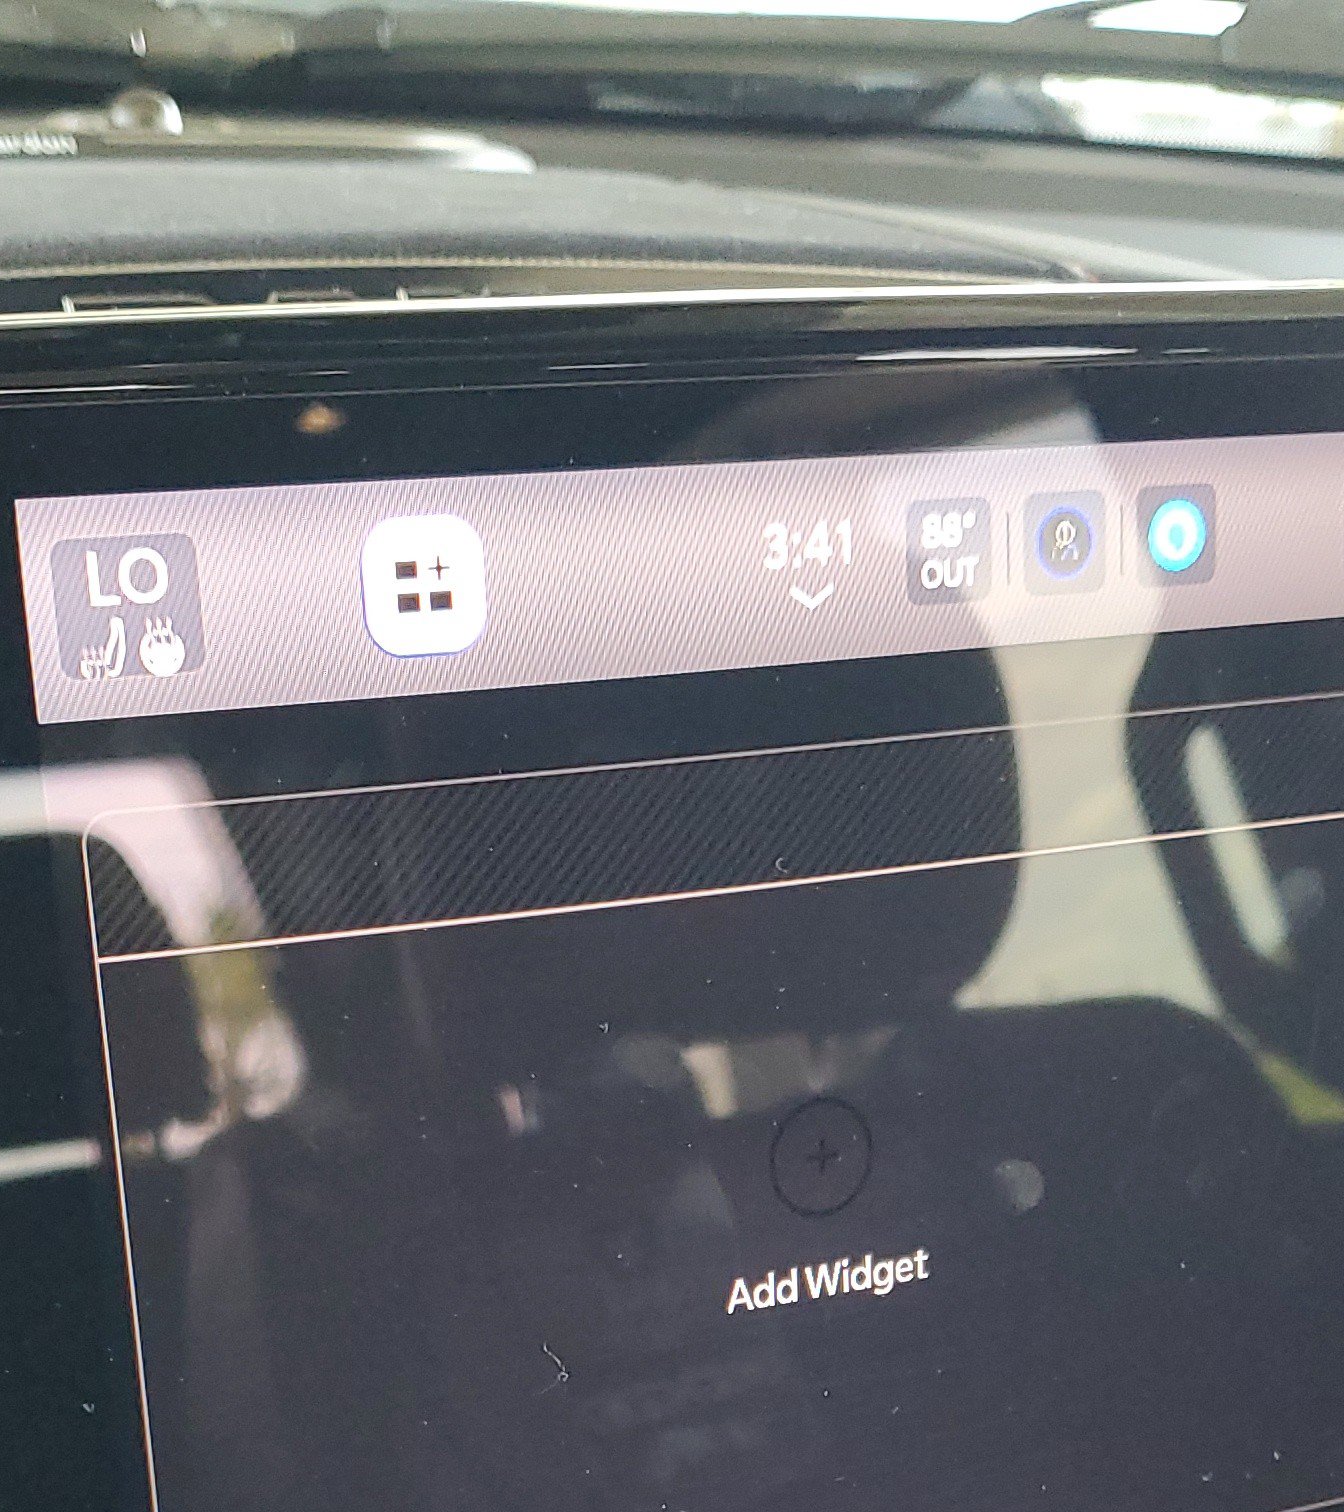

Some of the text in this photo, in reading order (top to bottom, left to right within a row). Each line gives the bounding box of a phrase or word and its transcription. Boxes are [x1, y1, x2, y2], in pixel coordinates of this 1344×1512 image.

[762, 518, 854, 571] 3:41
[920, 556, 980, 590] OUT
[85, 546, 169, 608] LO
[726, 1249, 930, 1315] Add Widget
